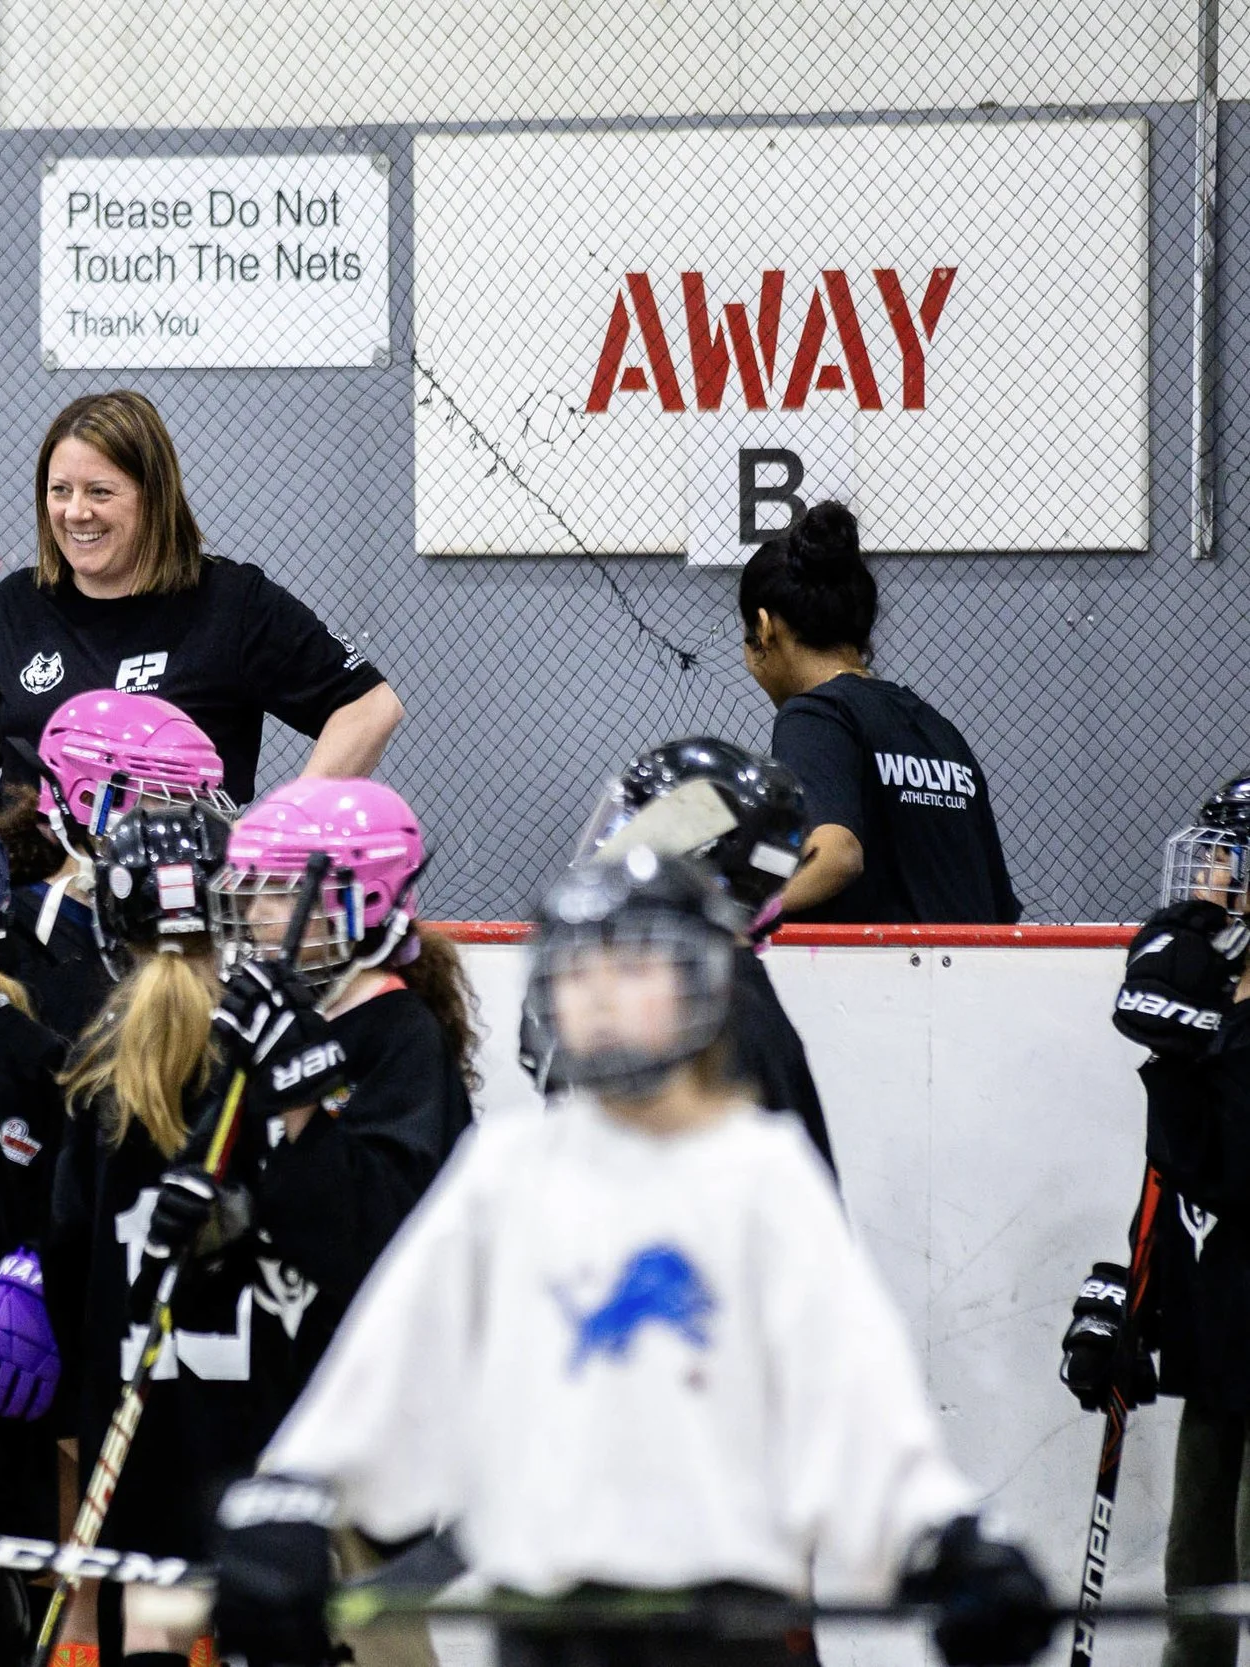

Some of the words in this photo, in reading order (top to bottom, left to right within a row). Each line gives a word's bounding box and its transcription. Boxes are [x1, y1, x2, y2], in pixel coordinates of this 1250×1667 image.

[67, 191, 192, 230] Please
[209, 189, 261, 228] Do
[277, 189, 341, 228] Not
[66, 245, 176, 283] Touch
[189, 244, 261, 283] The
[277, 243, 362, 282] Nets
[66, 310, 146, 338] Thank
[154, 310, 200, 338] You
[585, 267, 958, 415] AWAY
[738, 448, 808, 547] B
[874, 752, 976, 798] WOLVES
[900, 790, 944, 807] ATHLETIC
[945, 796, 967, 810] CLUB
